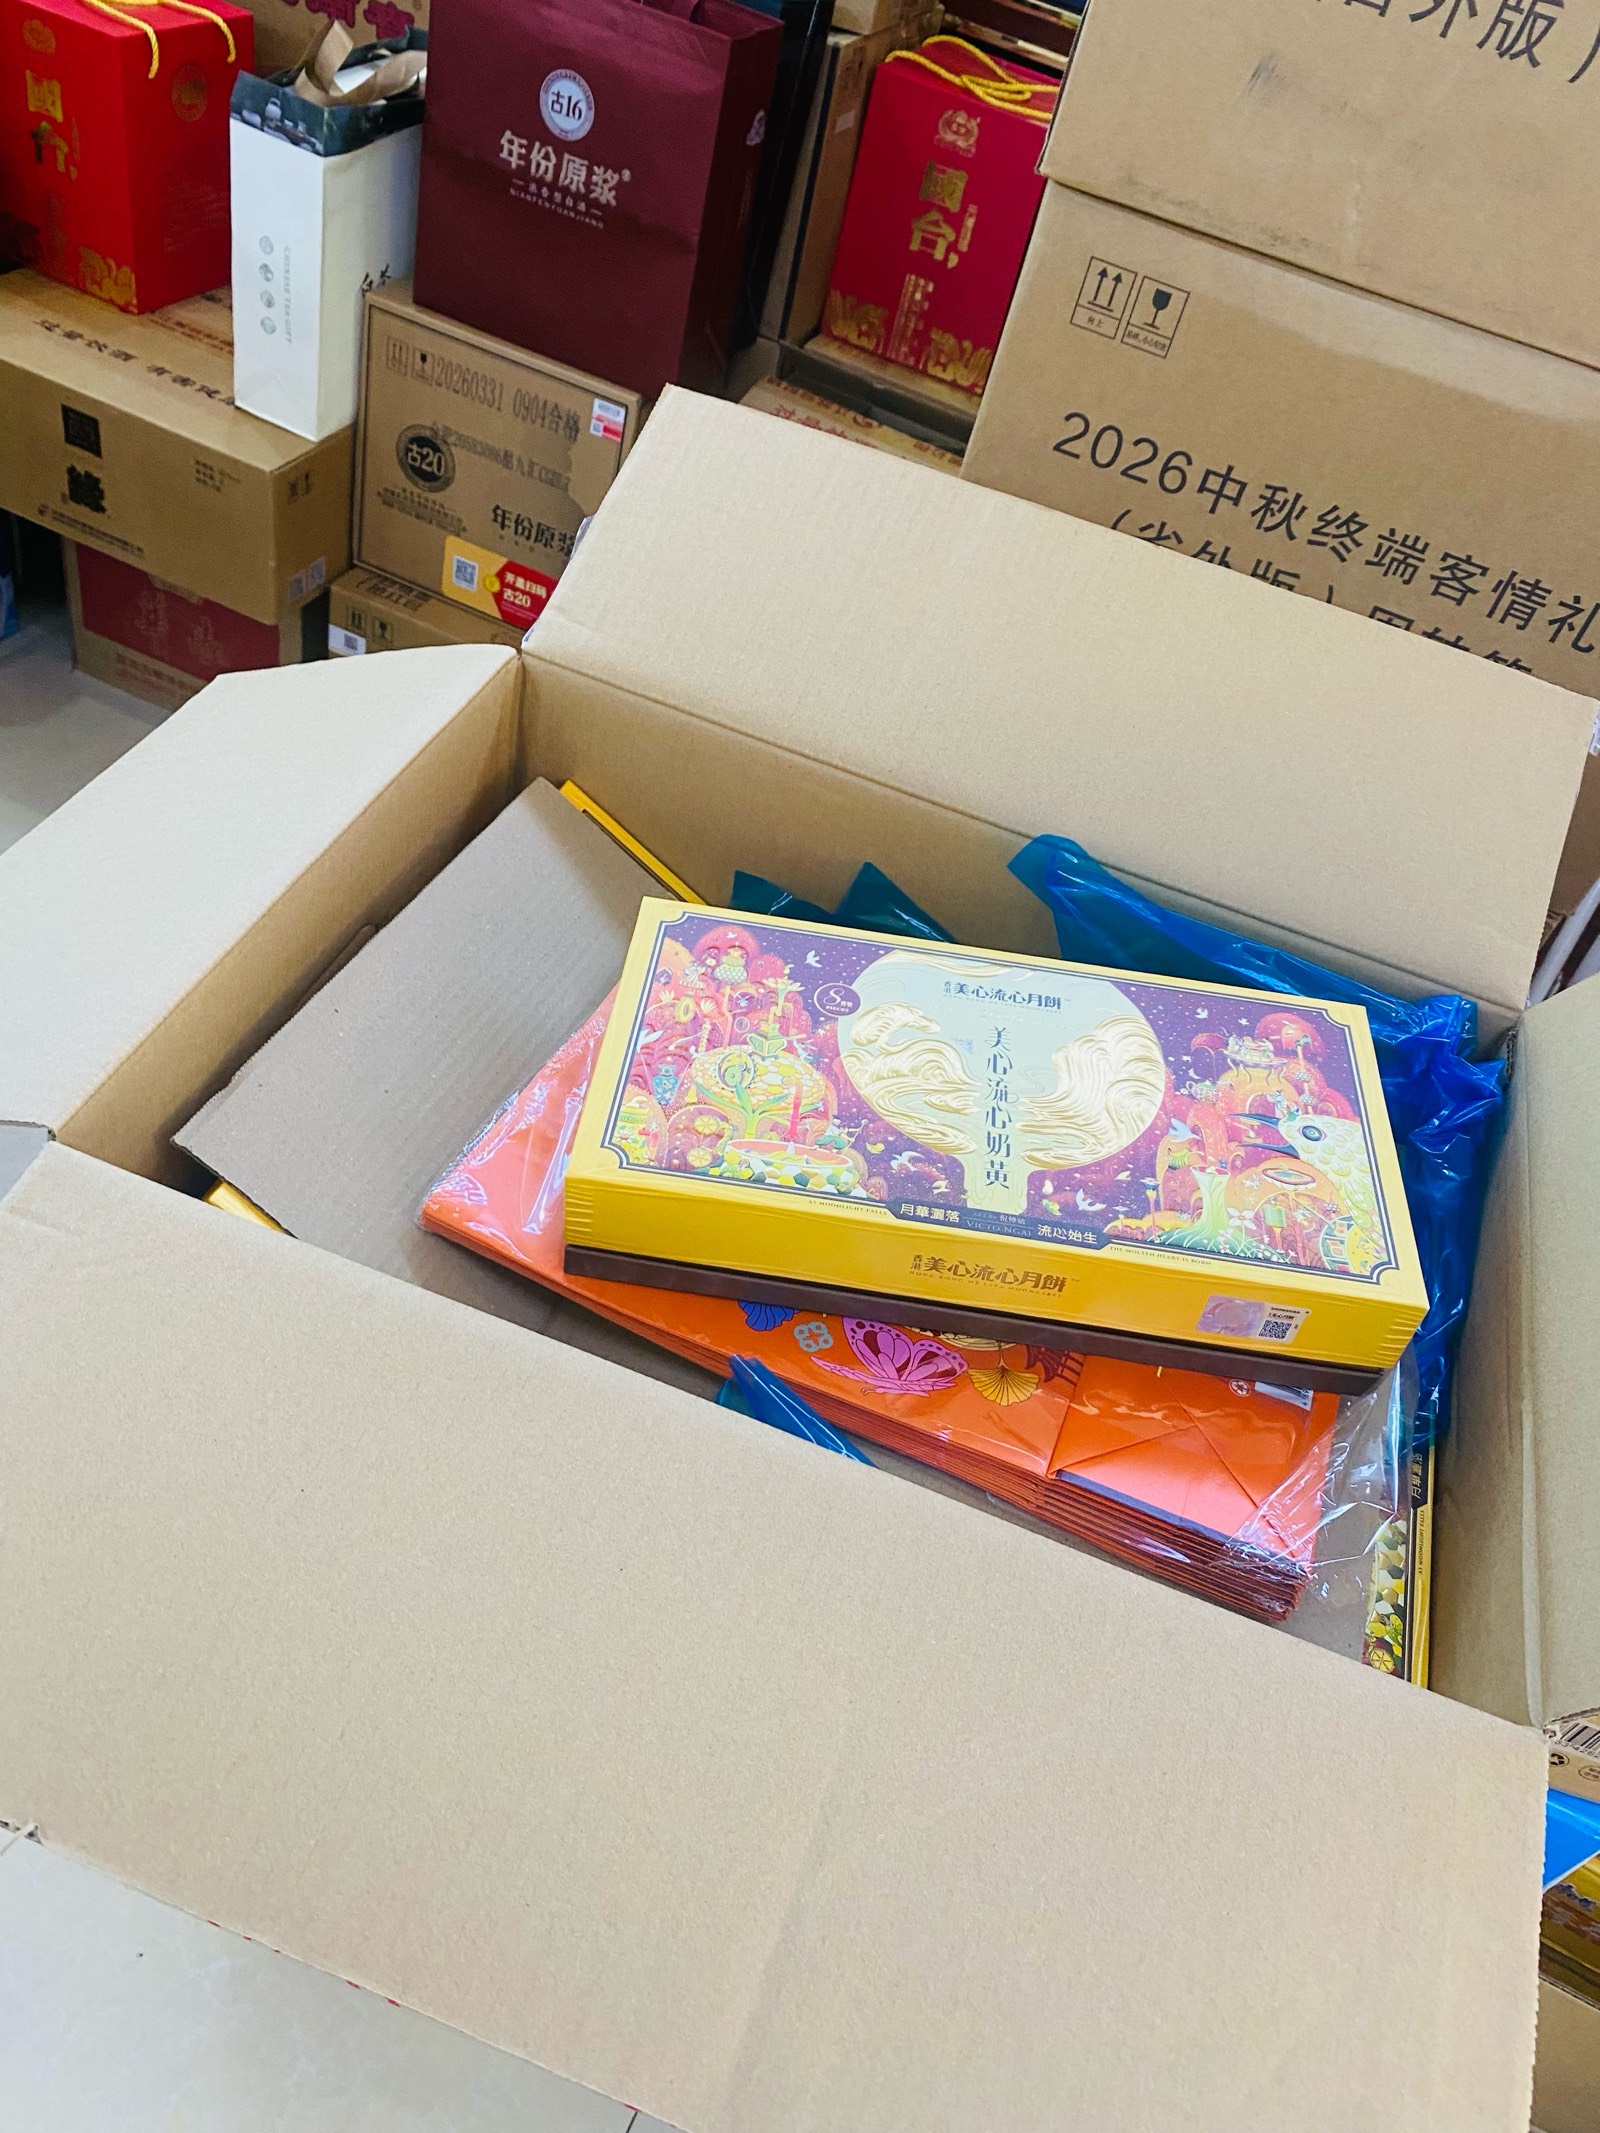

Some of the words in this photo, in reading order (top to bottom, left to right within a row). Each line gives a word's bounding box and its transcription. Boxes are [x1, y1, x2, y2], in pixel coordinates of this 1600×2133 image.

[551, 90, 582, 121] 古16
[407, 443, 446, 477] 古20
[1052, 411, 1600, 654] 2026中秋终端客情礼
[823, 988, 845, 1006] 8
[953, 982, 1062, 1010] 美心流心月餅
[818, 1201, 865, 1212] MOONLIGHT
[865, 1208, 888, 1216] FALLS
[1037, 1223, 1098, 1245] 流心始生
[1157, 1253, 1181, 1262] HEART
[924, 1256, 1069, 1293] 美心流心月餅
